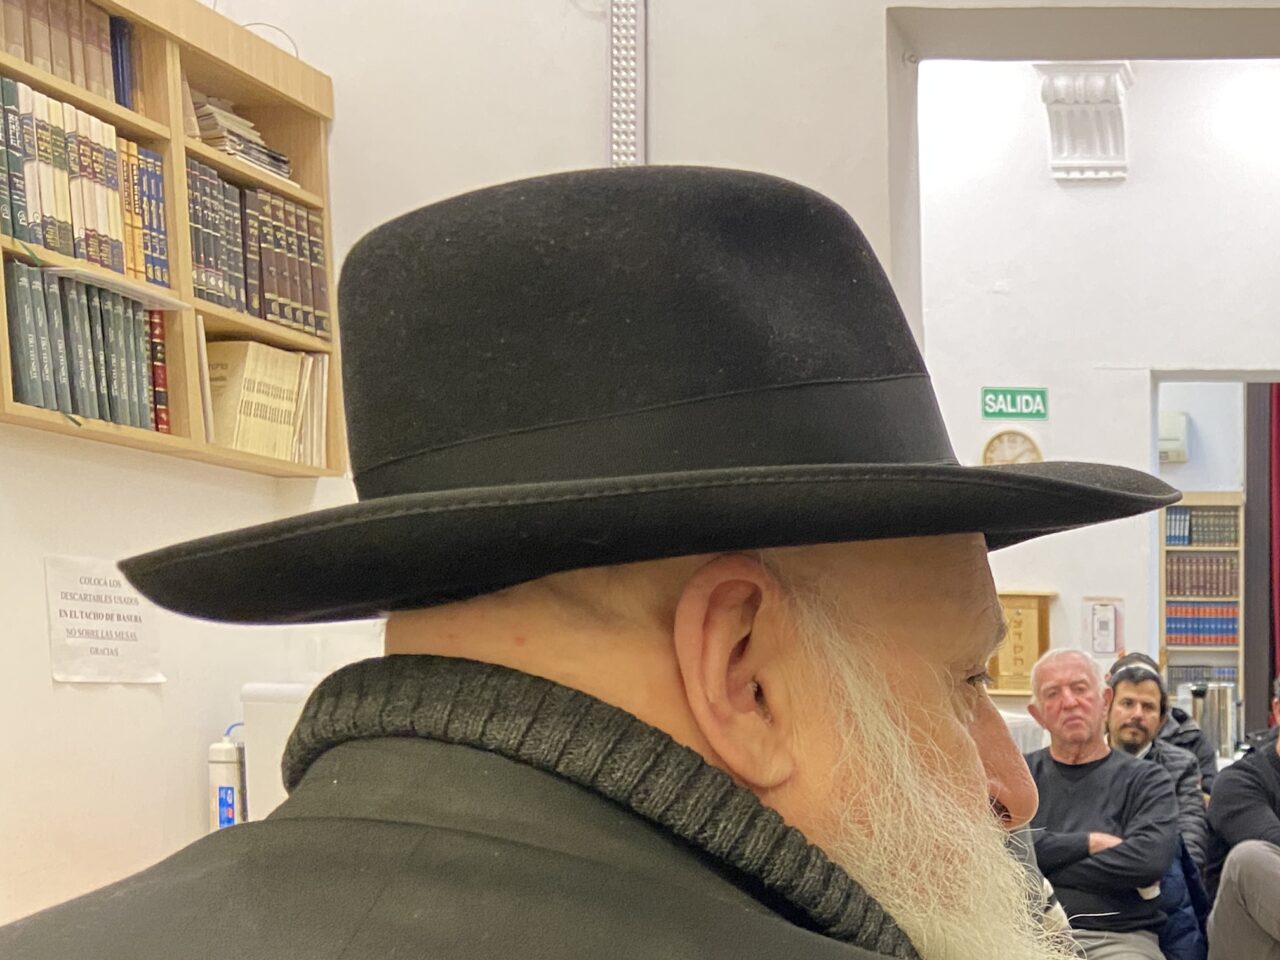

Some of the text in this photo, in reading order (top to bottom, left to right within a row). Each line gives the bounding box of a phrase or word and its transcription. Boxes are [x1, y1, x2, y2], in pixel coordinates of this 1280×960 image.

[984, 394, 1045, 413] SALIDA
[109, 579, 122, 588] LOS
[60, 592, 139, 606] DESCARTABLES USADOS
[59, 609, 142, 623] EN EL TACHO DE BASURA
[78, 628, 99, 638] SOBRE
[101, 630, 113, 639] LAS
[90, 647, 118, 656] GRACIAS
